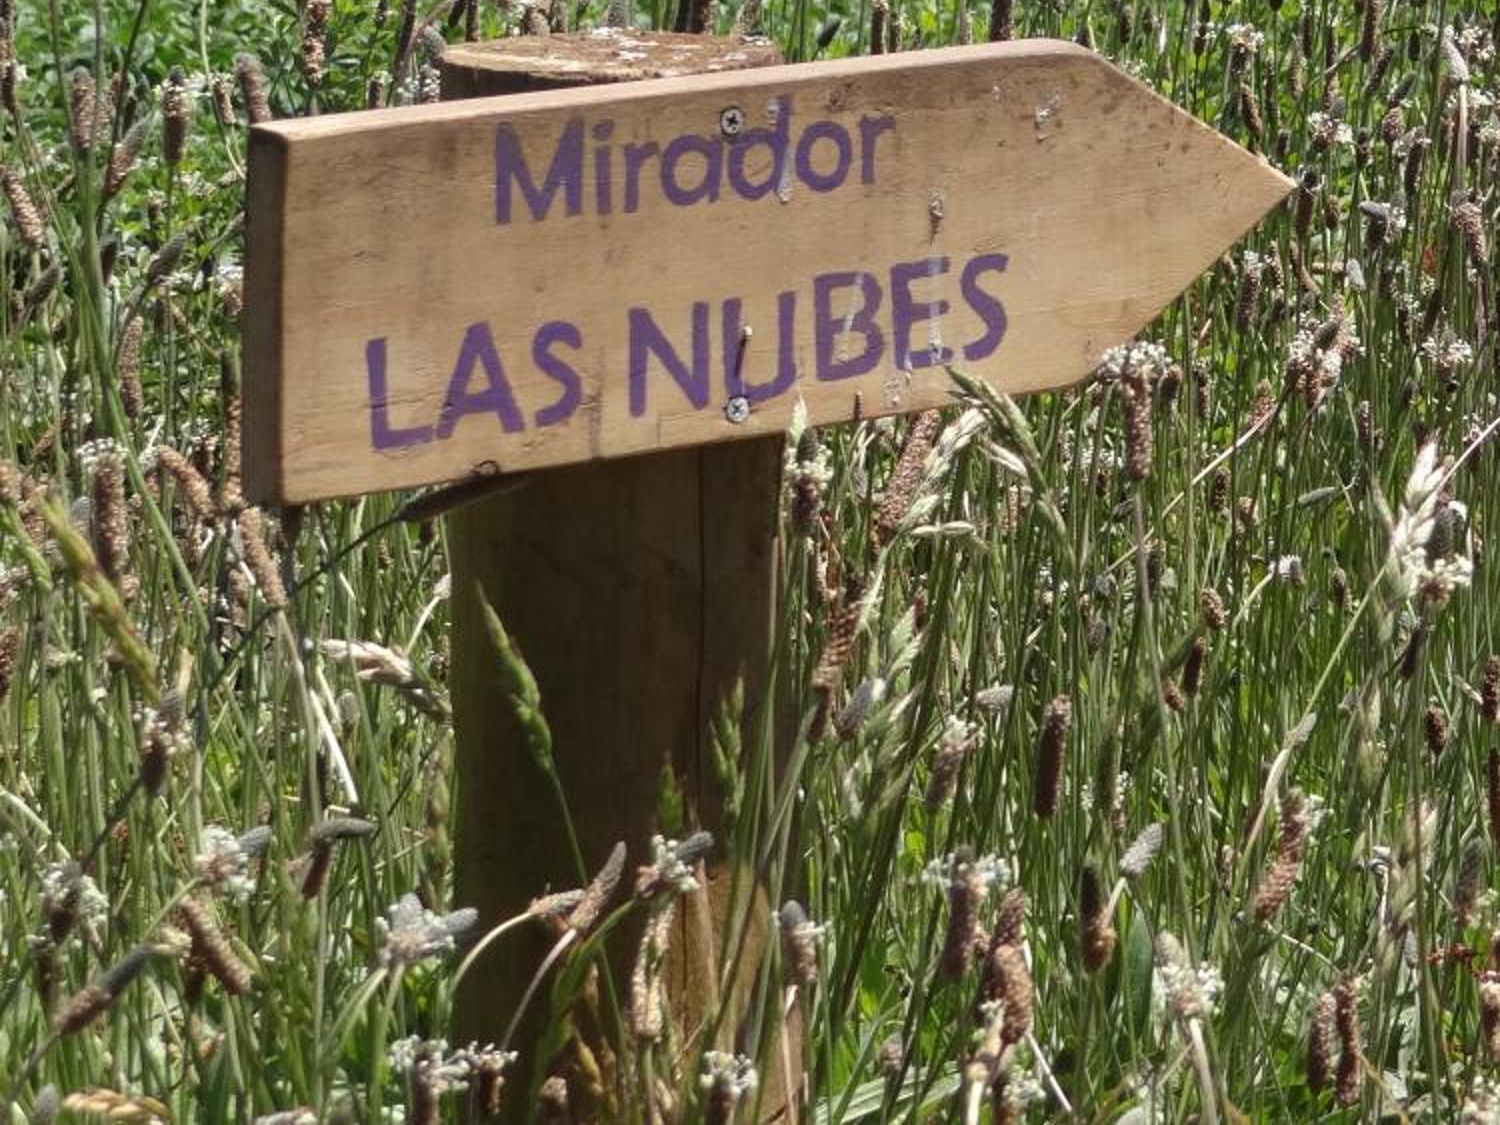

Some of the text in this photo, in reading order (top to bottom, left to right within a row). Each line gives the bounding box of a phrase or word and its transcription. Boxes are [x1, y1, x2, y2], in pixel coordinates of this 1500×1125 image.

[495, 96, 895, 225] Mirador
[365, 253, 1009, 450] LAS NUBES
